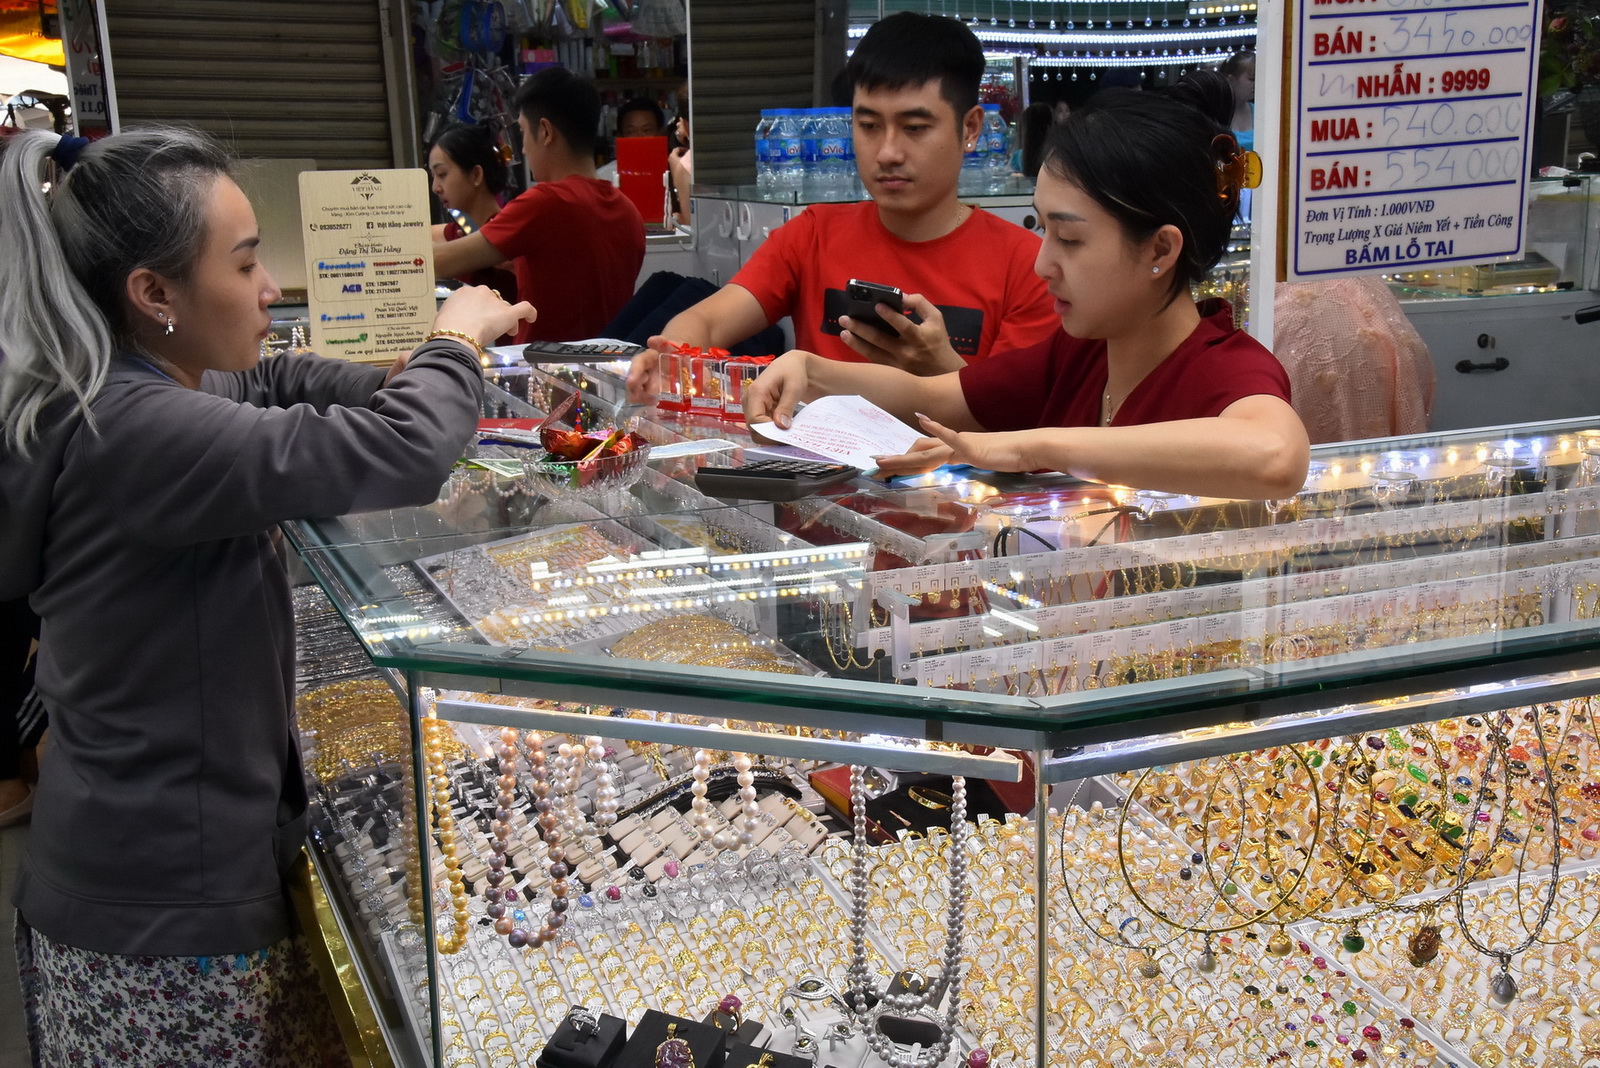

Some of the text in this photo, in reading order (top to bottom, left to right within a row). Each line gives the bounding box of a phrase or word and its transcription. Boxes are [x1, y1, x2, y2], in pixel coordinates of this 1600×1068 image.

[1314, 26, 1362, 55] BÁN
[1370, 36, 1376, 51] :
[1357, 63, 1421, 98] NHẪN
[1429, 77, 1434, 92] :
[1442, 69, 1490, 92] 9999
[1311, 118, 1359, 142] MUA
[1367, 122, 1372, 137] :
[1311, 162, 1358, 190] BÁN
[1365, 171, 1371, 186] :
[1306, 210, 1328, 222] Đơn
[1333, 208, 1344, 222] Vị
[1348, 205, 1371, 219] Tính
[1381, 200, 1435, 216] 1.000VNĐ
[1305, 231, 1334, 245] Trọng
[1338, 228, 1370, 242] Lượng
[1373, 225, 1381, 238] X
[1385, 224, 1402, 237] Giá
[1406, 221, 1432, 235] Niêm
[1436, 217, 1450, 232] Yết
[1464, 213, 1485, 228] Tiền
[1488, 214, 1513, 228] Công
[384, 245, 401, 253] Hằng
[1346, 237, 1454, 264] BẤM LỖ TAI
[342, 284, 362, 293] ACB
